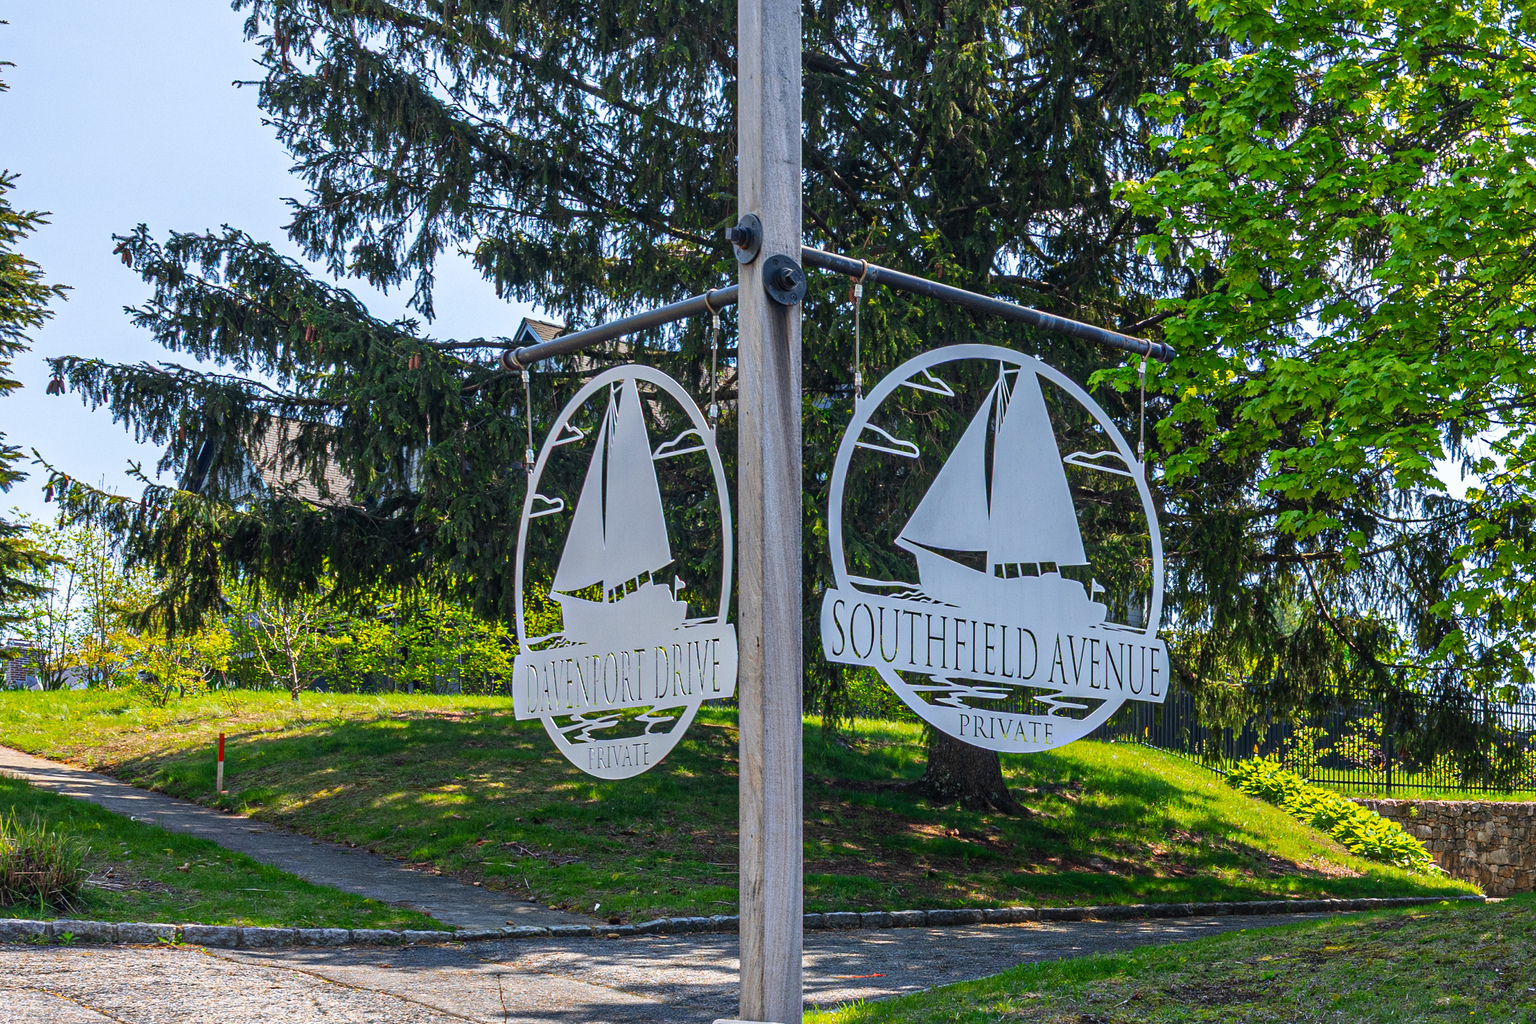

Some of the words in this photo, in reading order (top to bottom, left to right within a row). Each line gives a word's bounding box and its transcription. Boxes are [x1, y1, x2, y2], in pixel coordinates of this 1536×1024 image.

[831, 599, 1039, 681] SOUTHFIELD
[1047, 633, 1162, 698] AVENUE
[525, 648, 646, 714] DAVENPORT
[654, 638, 721, 699] DRIVE
[588, 742, 650, 770] PRIVATE
[959, 713, 1054, 746] PRIVATE
